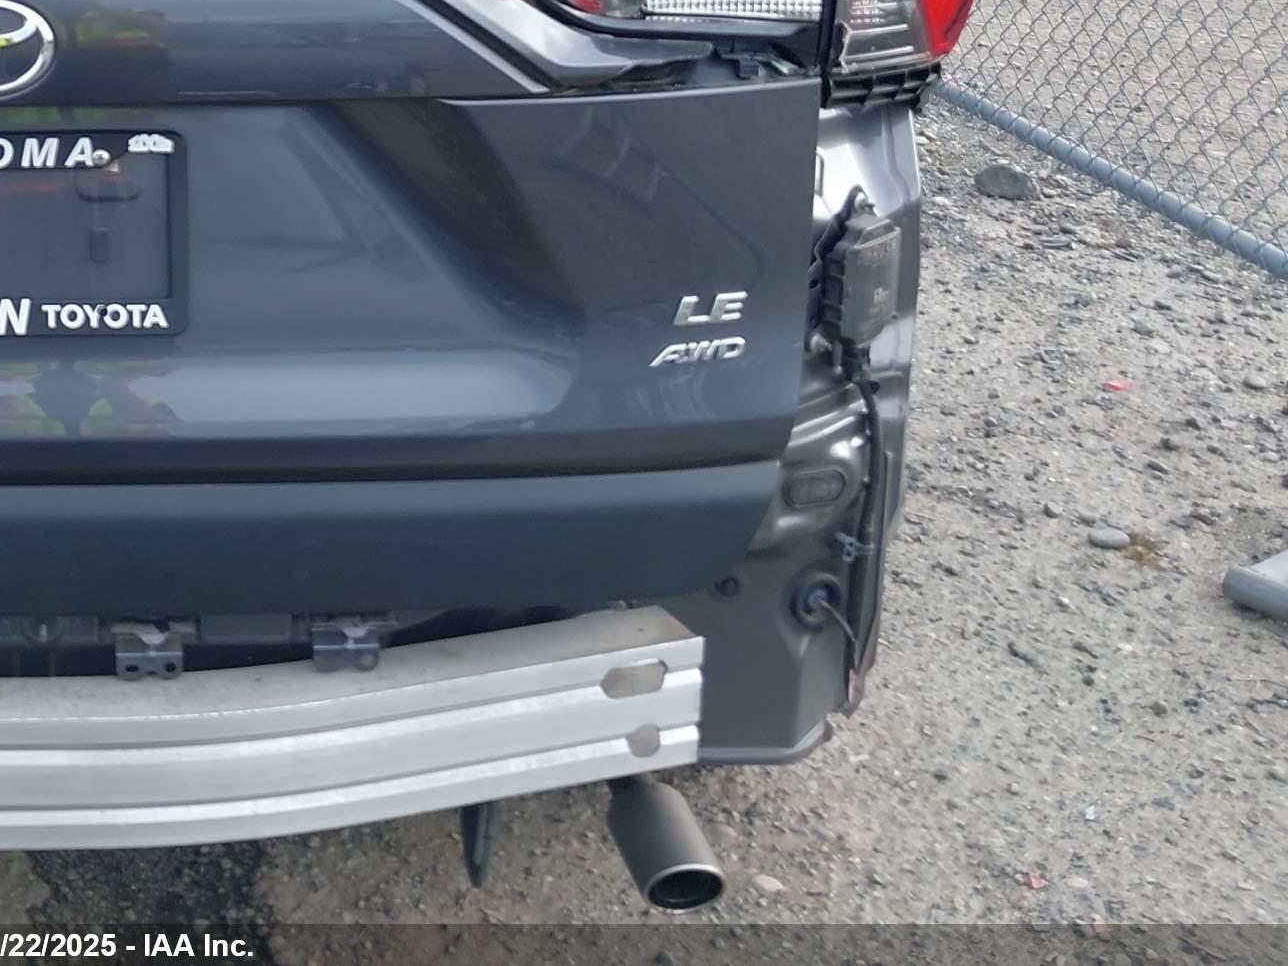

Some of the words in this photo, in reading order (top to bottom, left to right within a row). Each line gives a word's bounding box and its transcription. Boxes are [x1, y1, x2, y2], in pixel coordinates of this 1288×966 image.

[41, 303, 169, 330] TOYOTA
[673, 291, 748, 326] LE
[649, 336, 746, 368] AWD
